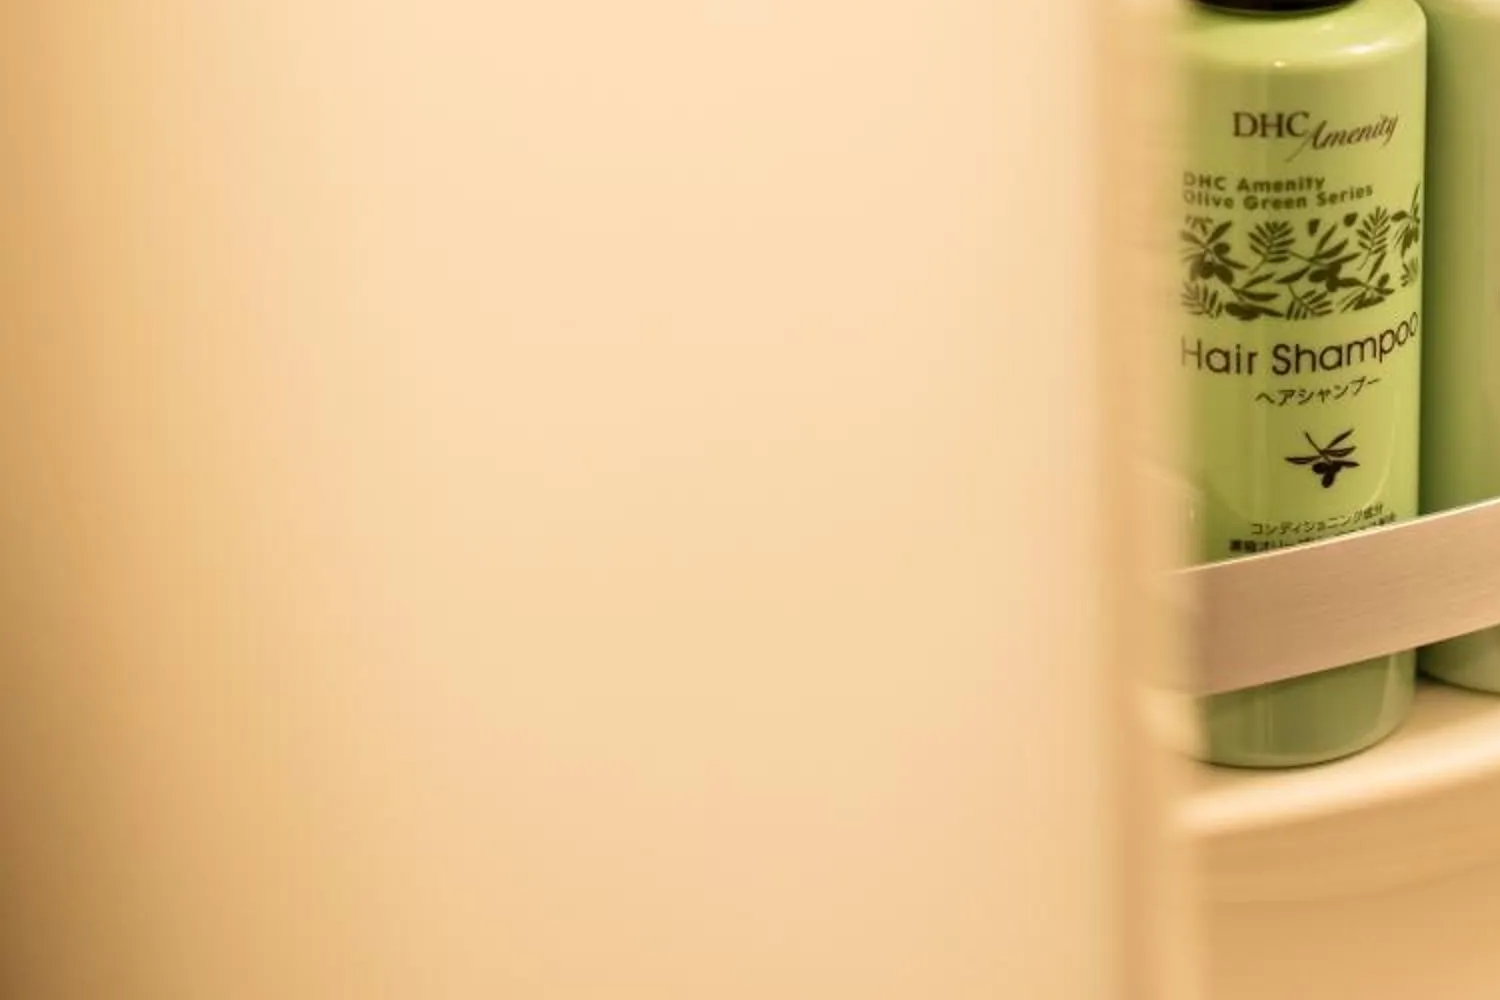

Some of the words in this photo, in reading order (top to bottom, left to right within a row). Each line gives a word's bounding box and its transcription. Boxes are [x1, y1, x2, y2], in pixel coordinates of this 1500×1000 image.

[1233, 110, 1310, 138] DHC
[1284, 113, 1399, 163] Amenity
[1183, 172, 1226, 191] DHC
[1237, 176, 1325, 193] Amenity
[1183, 190, 1234, 209] Olive
[1243, 195, 1307, 210] Green
[1316, 184, 1373, 207] Series
[1181, 335, 1258, 376] Hair
[1271, 311, 1418, 376] Shampoo
[1255, 376, 1380, 407] ヘアシャンプー
